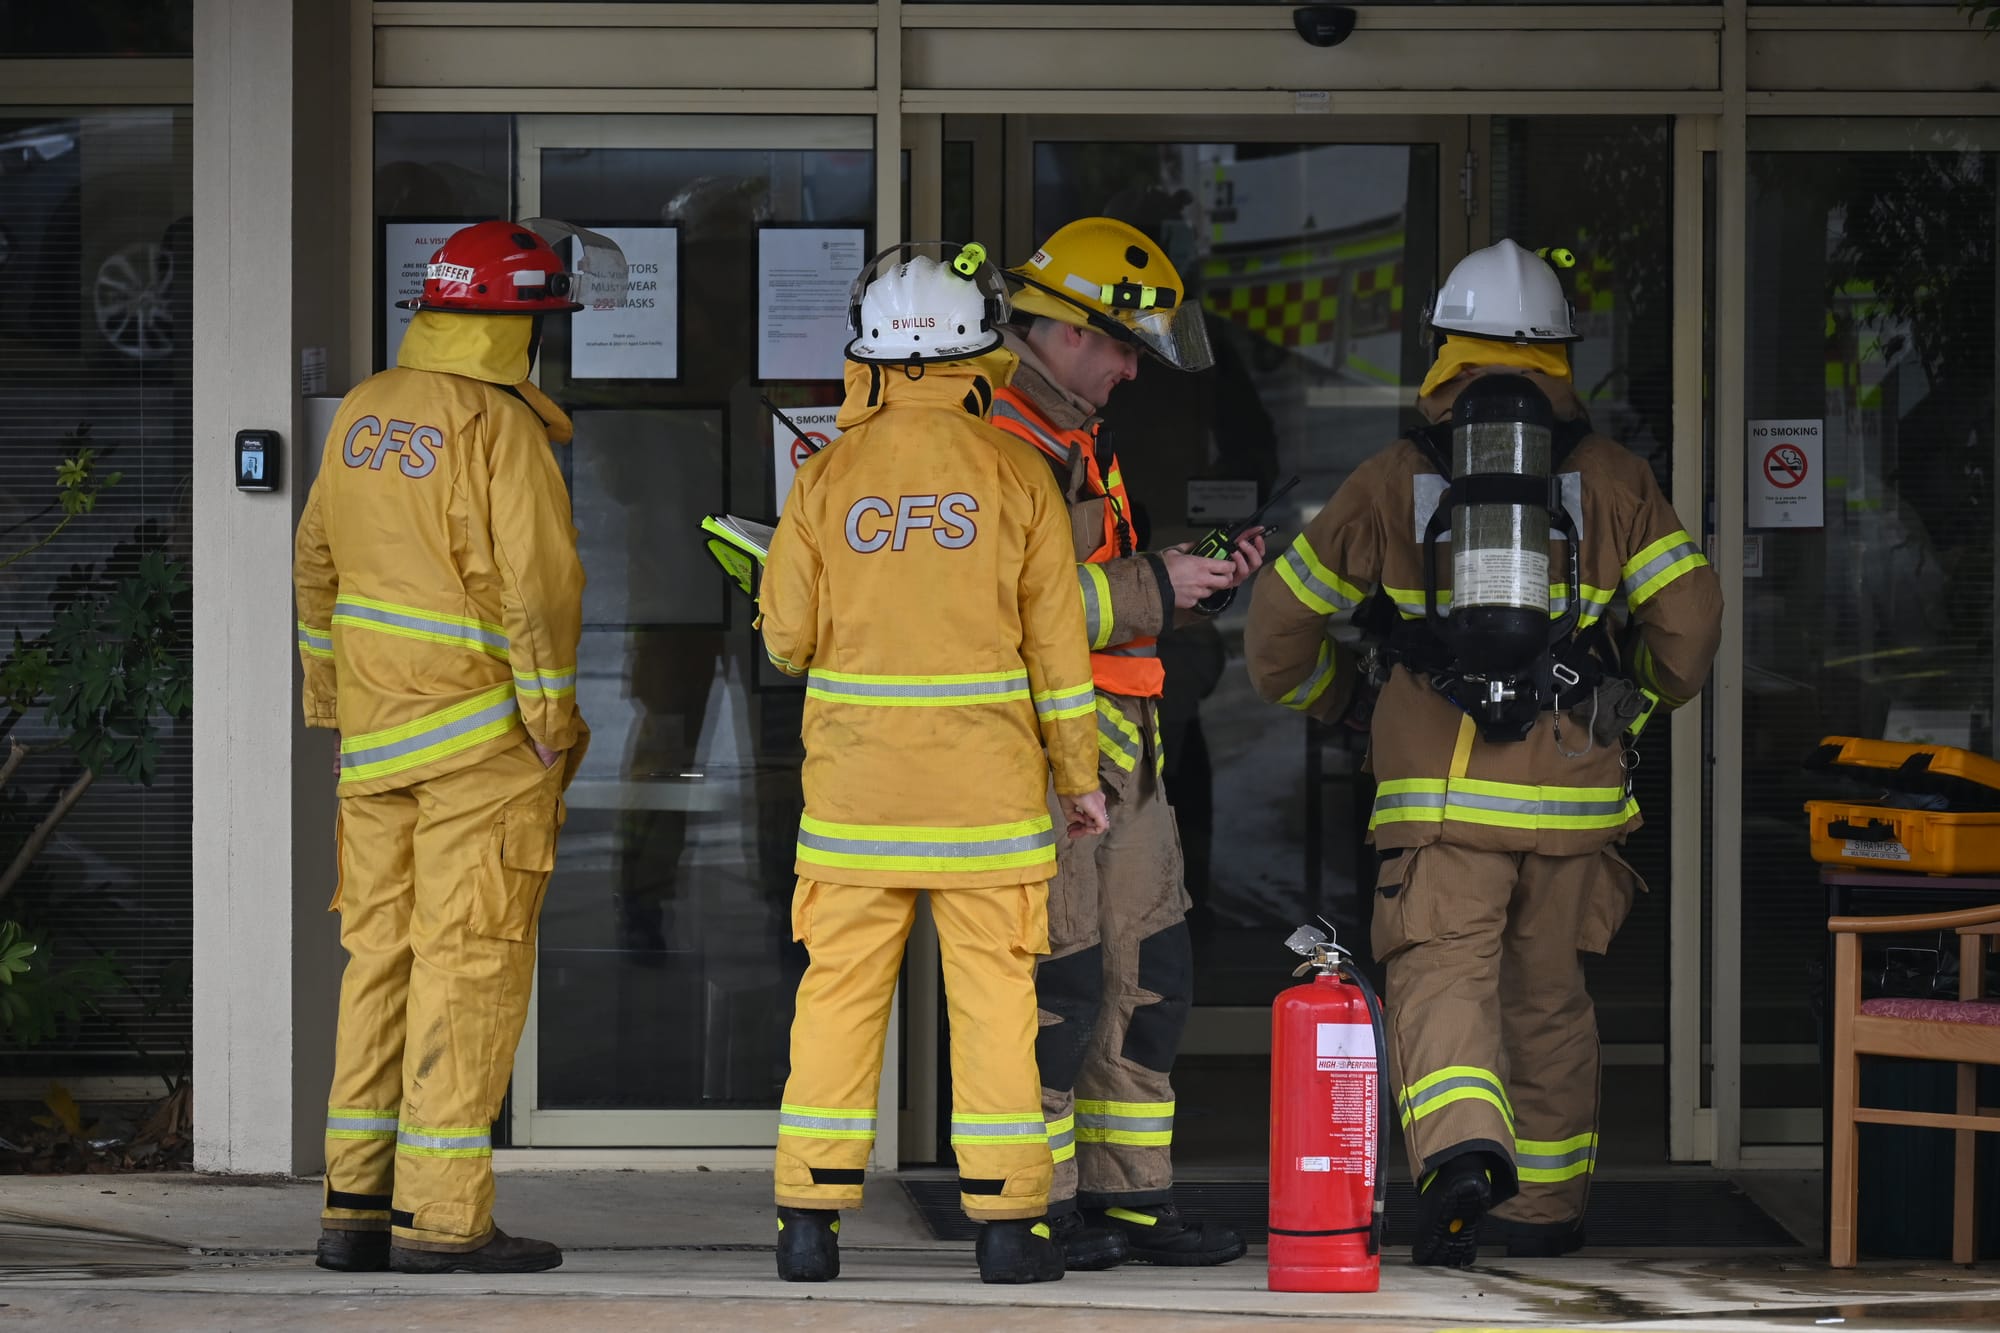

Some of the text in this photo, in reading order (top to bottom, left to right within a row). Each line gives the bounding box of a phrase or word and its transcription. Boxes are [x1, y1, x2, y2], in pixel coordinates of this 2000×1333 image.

[624, 281, 657, 291] WEAR
[892, 317, 936, 330] B WILLIS
[796, 414, 837, 426] SMOKIN
[1753, 427, 1818, 437] NO SMOKING
[342, 414, 443, 479] CFS
[844, 492, 979, 554] CFS
[1318, 1060, 1336, 1069] HIGH
[1364, 1099, 1372, 1138] POWDER
